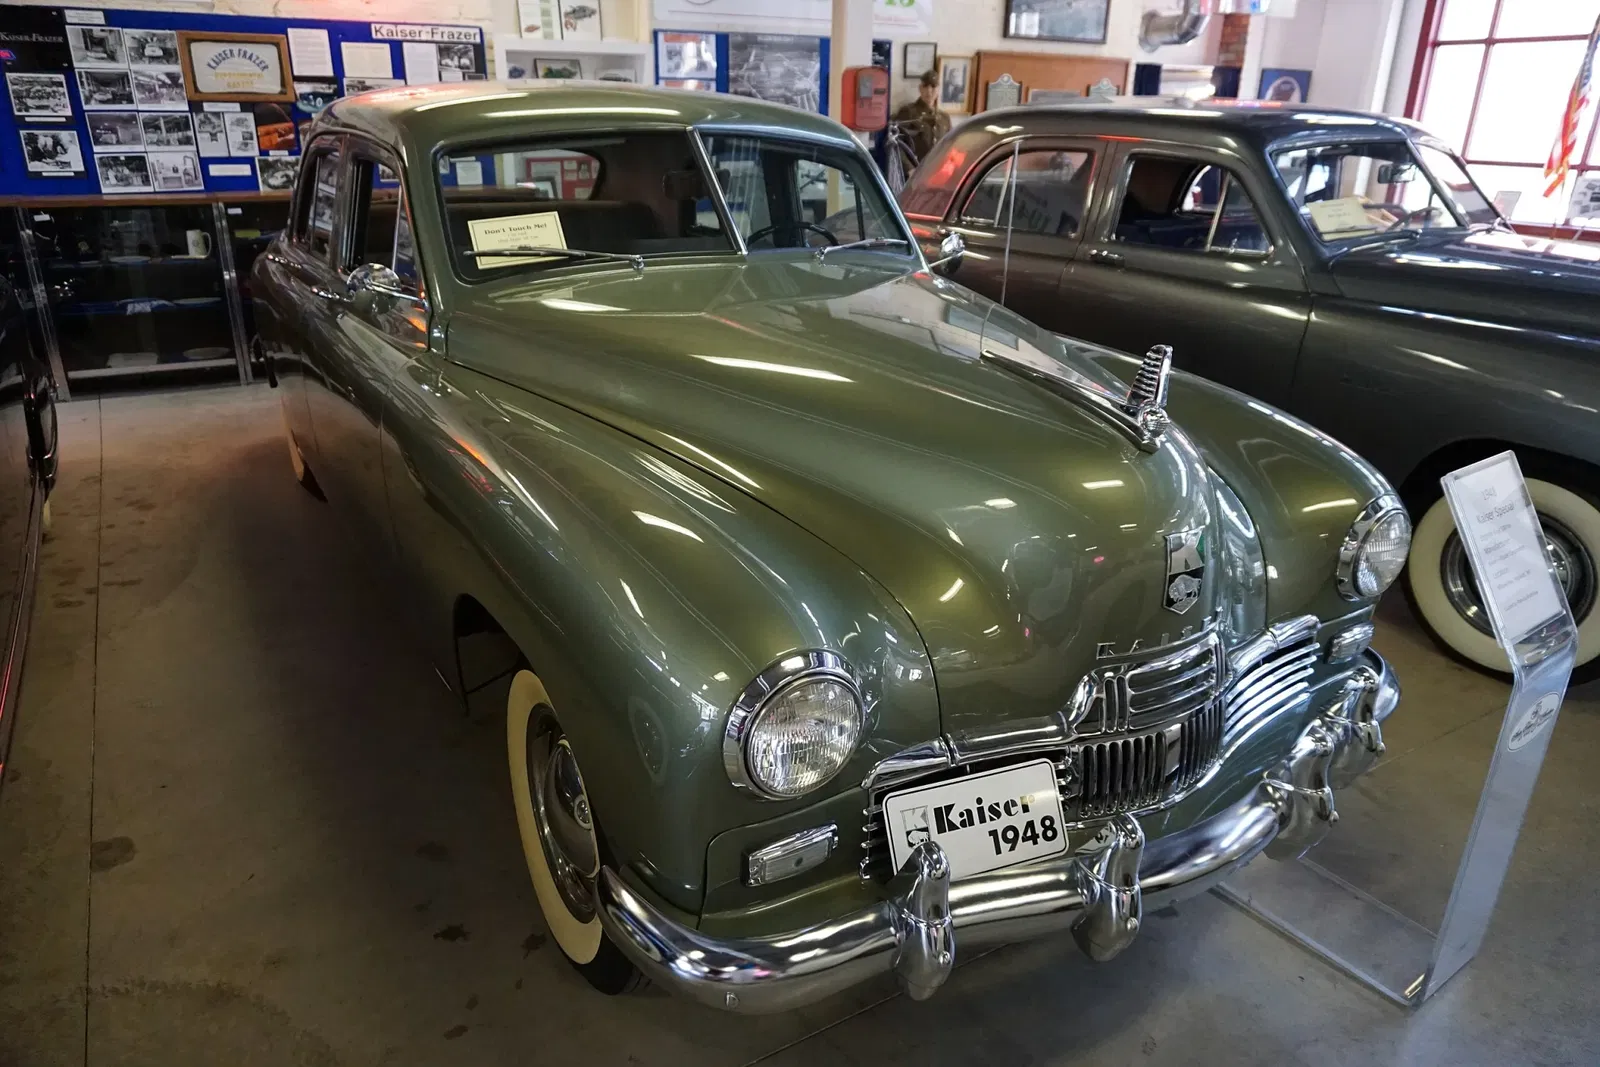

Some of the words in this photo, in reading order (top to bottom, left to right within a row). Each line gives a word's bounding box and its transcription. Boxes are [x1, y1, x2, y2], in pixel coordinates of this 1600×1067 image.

[374, 25, 477, 40] Kaiser-Frazer
[207, 48, 235, 70] KAISER
[238, 48, 269, 72] FRAZER
[484, 228, 506, 236] Don't
[508, 224, 532, 232] Touch
[934, 795, 1035, 835] Kaiser
[988, 815, 1058, 856] 1948
